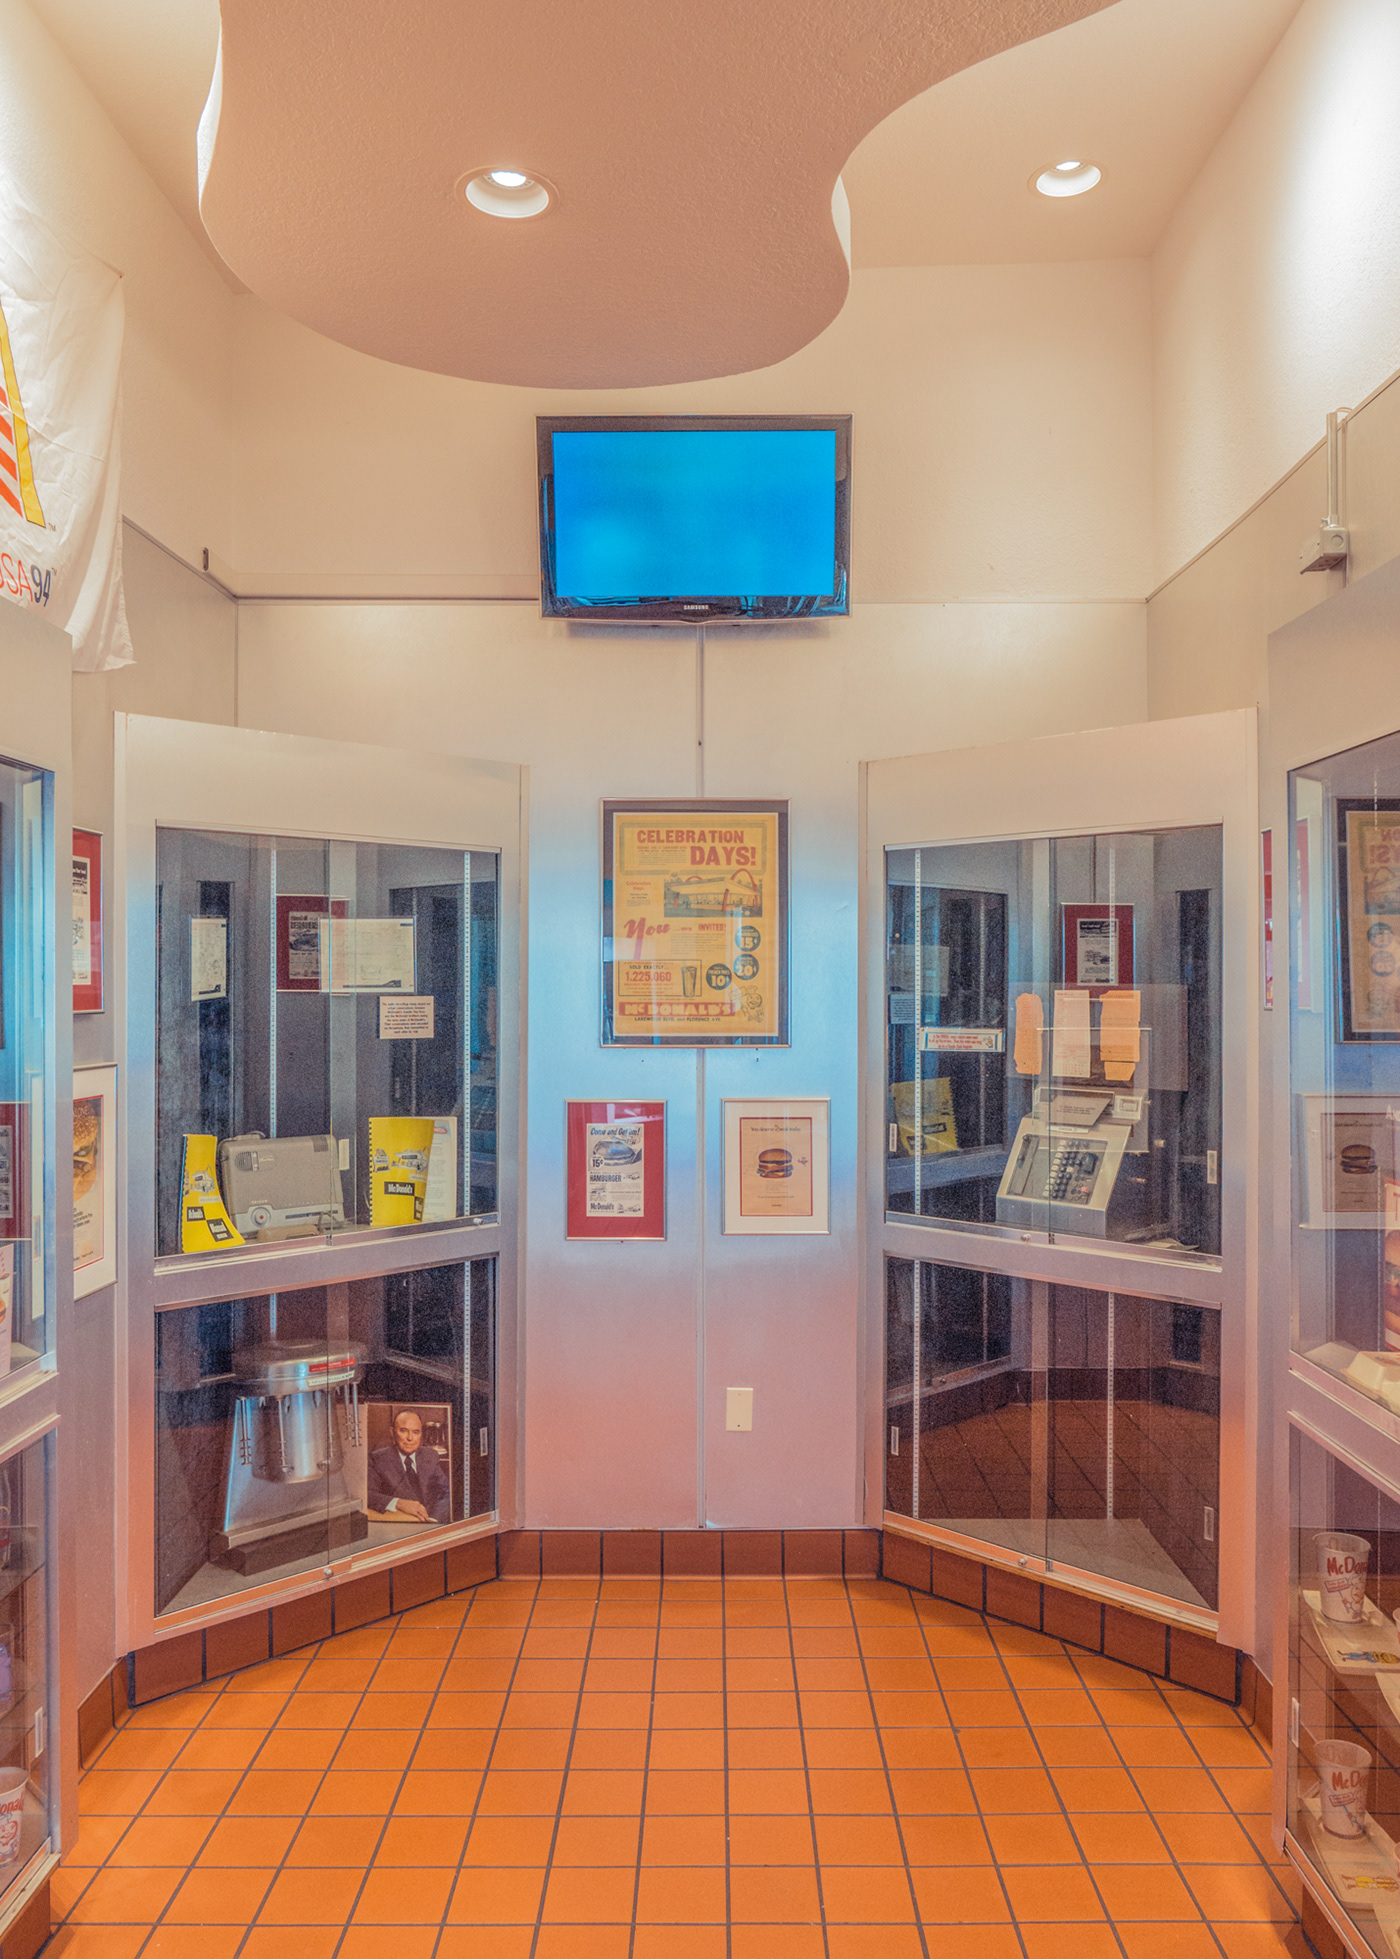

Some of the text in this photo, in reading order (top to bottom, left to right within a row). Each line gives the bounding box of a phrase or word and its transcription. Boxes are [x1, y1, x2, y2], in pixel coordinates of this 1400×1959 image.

[636, 829, 744, 844] CELEBRATION
[690, 846, 757, 866] DAYS!
[623, 917, 671, 961] You
[698, 923, 727, 932] INVITED!
[607, 1127, 618, 1136] and
[589, 1174, 622, 1182] HAMBURGER
[388, 1183, 413, 1193] McDonald's
[590, 1202, 615, 1210] McDonald's
